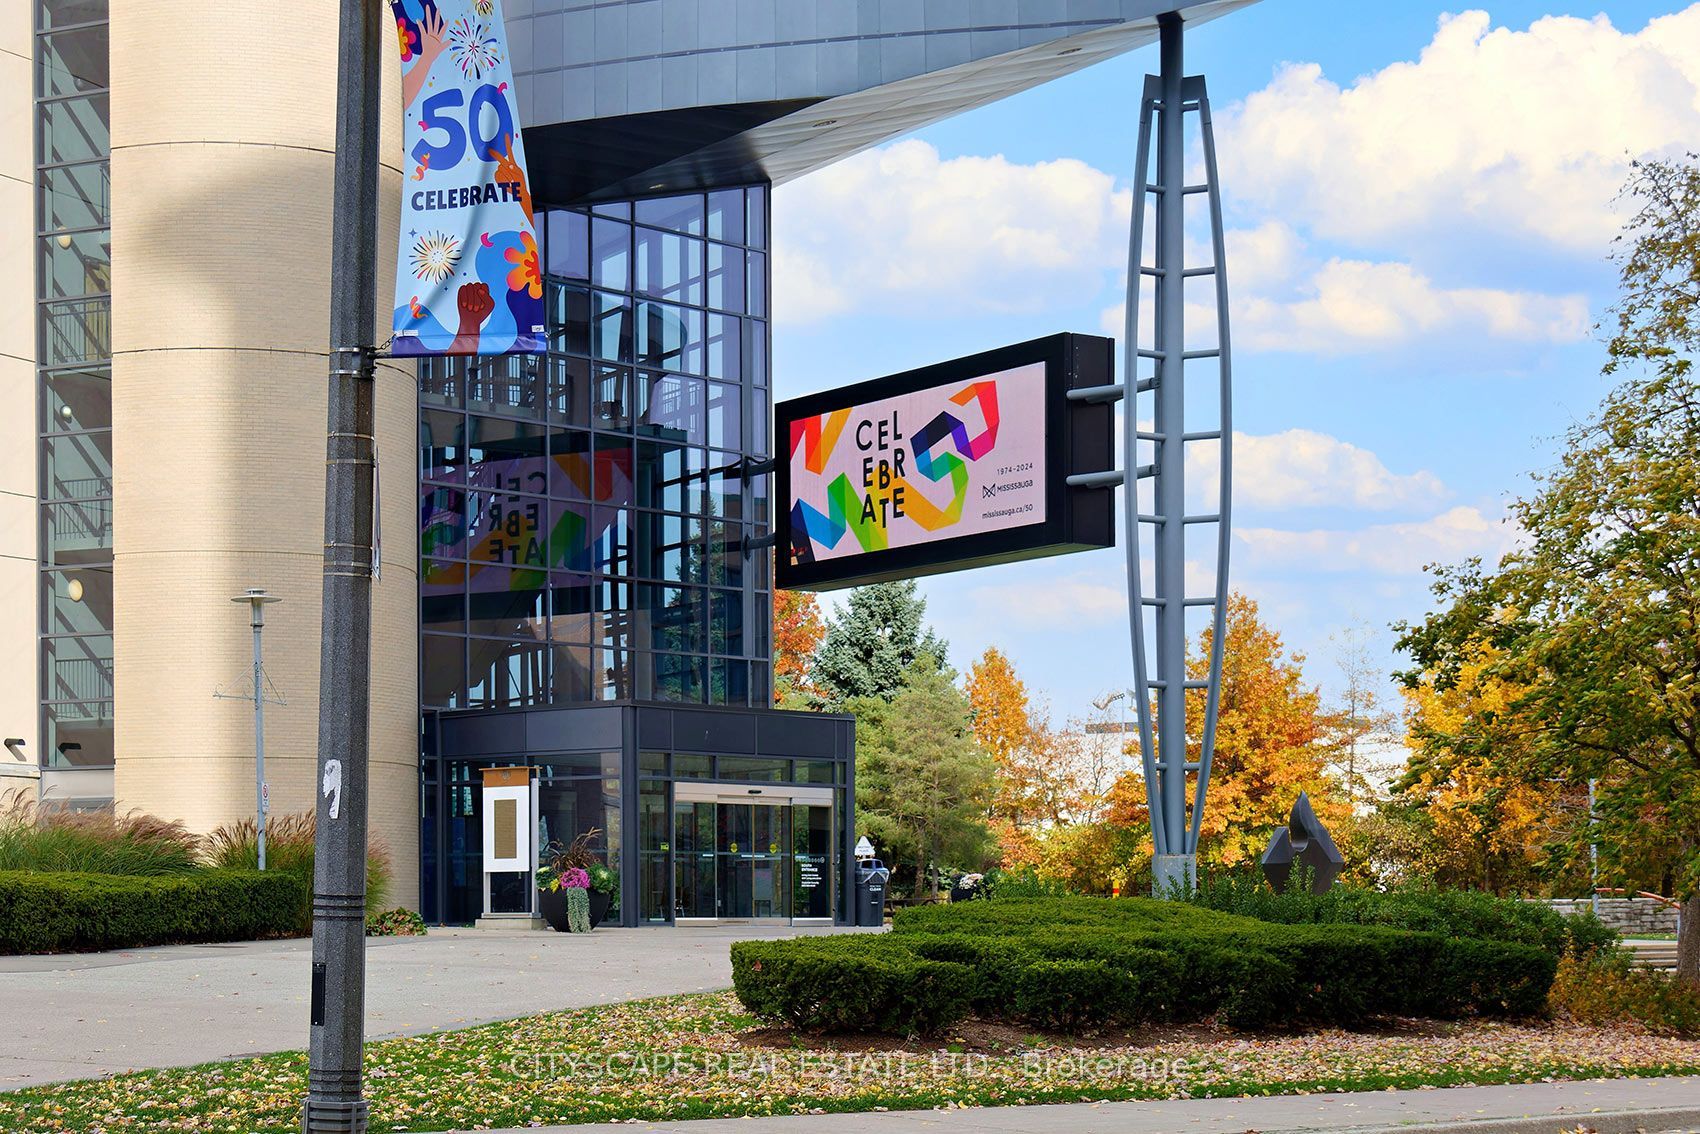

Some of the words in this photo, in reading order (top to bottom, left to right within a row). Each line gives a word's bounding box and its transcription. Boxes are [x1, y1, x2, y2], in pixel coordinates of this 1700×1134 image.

[411, 83, 514, 170] 50
[411, 181, 522, 211] CELEBRATE
[856, 410, 902, 451] CEL
[863, 447, 905, 490] EBR
[860, 487, 904, 528] ATE
[982, 503, 1033, 519] mississauga.ca/50
